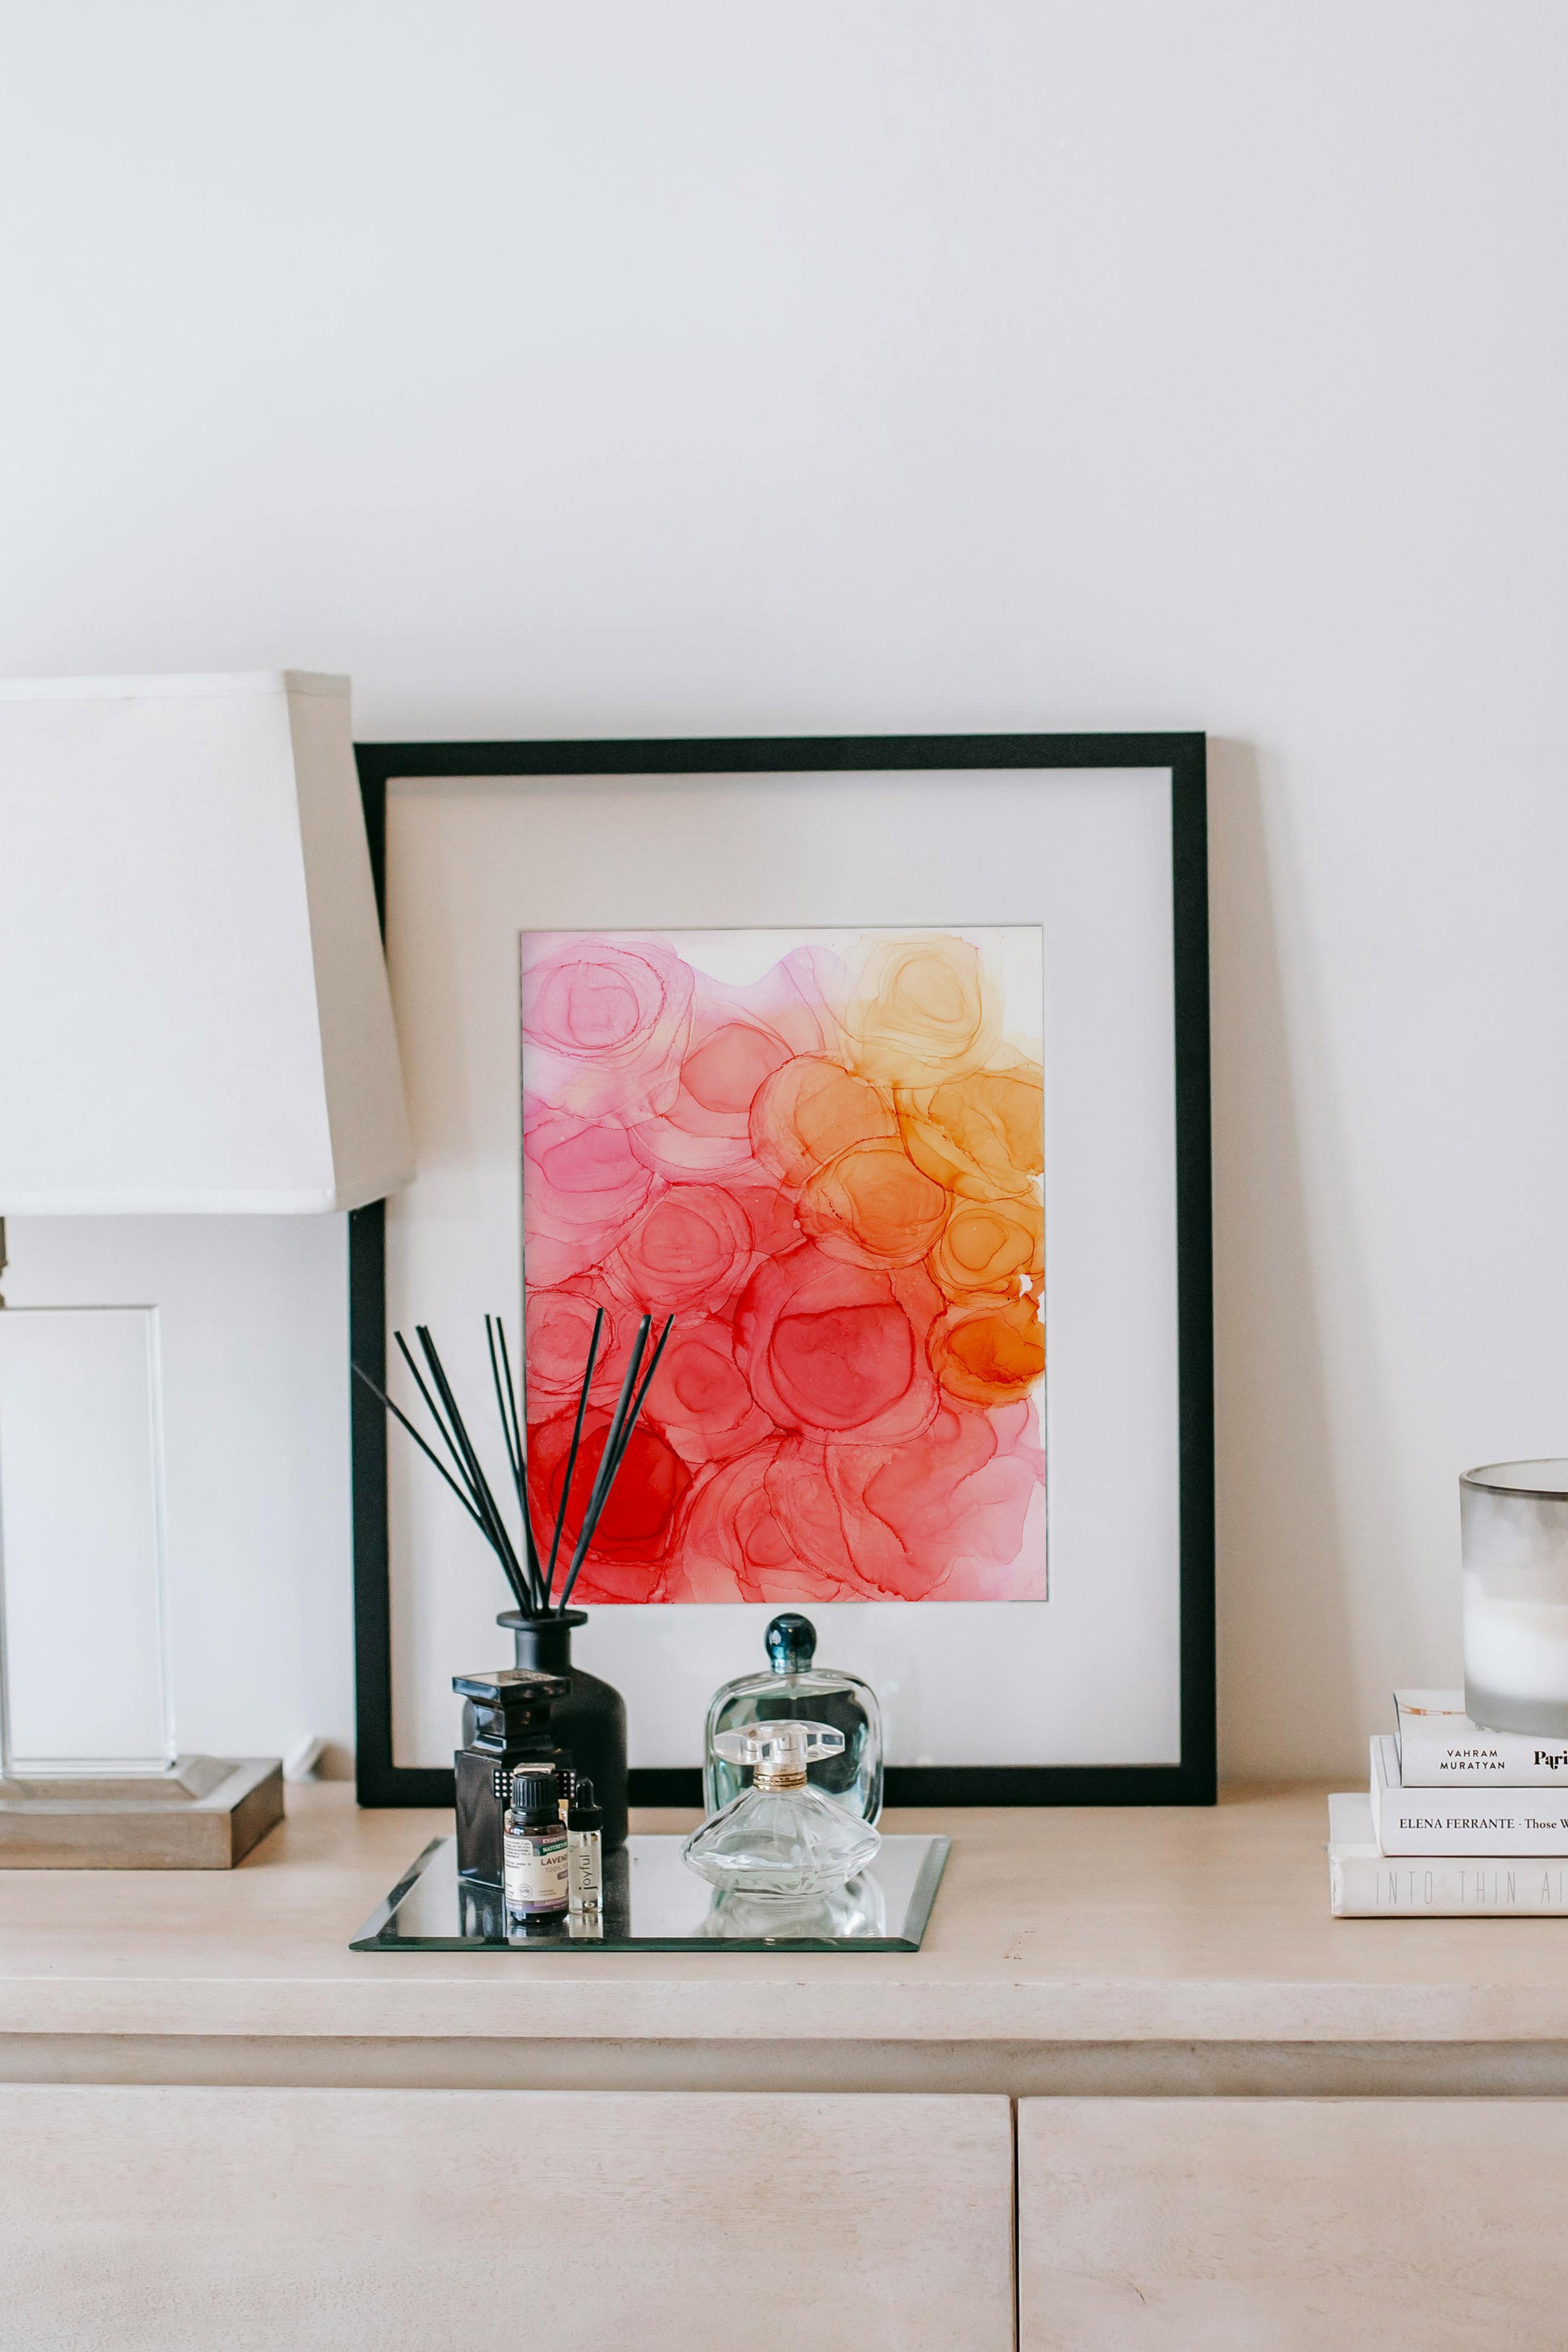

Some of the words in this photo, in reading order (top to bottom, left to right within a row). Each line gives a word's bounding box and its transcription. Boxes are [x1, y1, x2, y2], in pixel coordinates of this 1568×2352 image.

[1440, 1761, 1505, 1769] MURATYAN
[1533, 1750, 1568, 1769] Pari
[1400, 1819, 1442, 1829] ELENA
[1446, 1819, 1515, 1829] FERRANTE
[1524, 1819, 1557, 1829] Those
[579, 1855, 598, 1890] joyful
[1376, 1871, 1433, 1904] INTO
[1459, 1871, 1515, 1904] THIN
